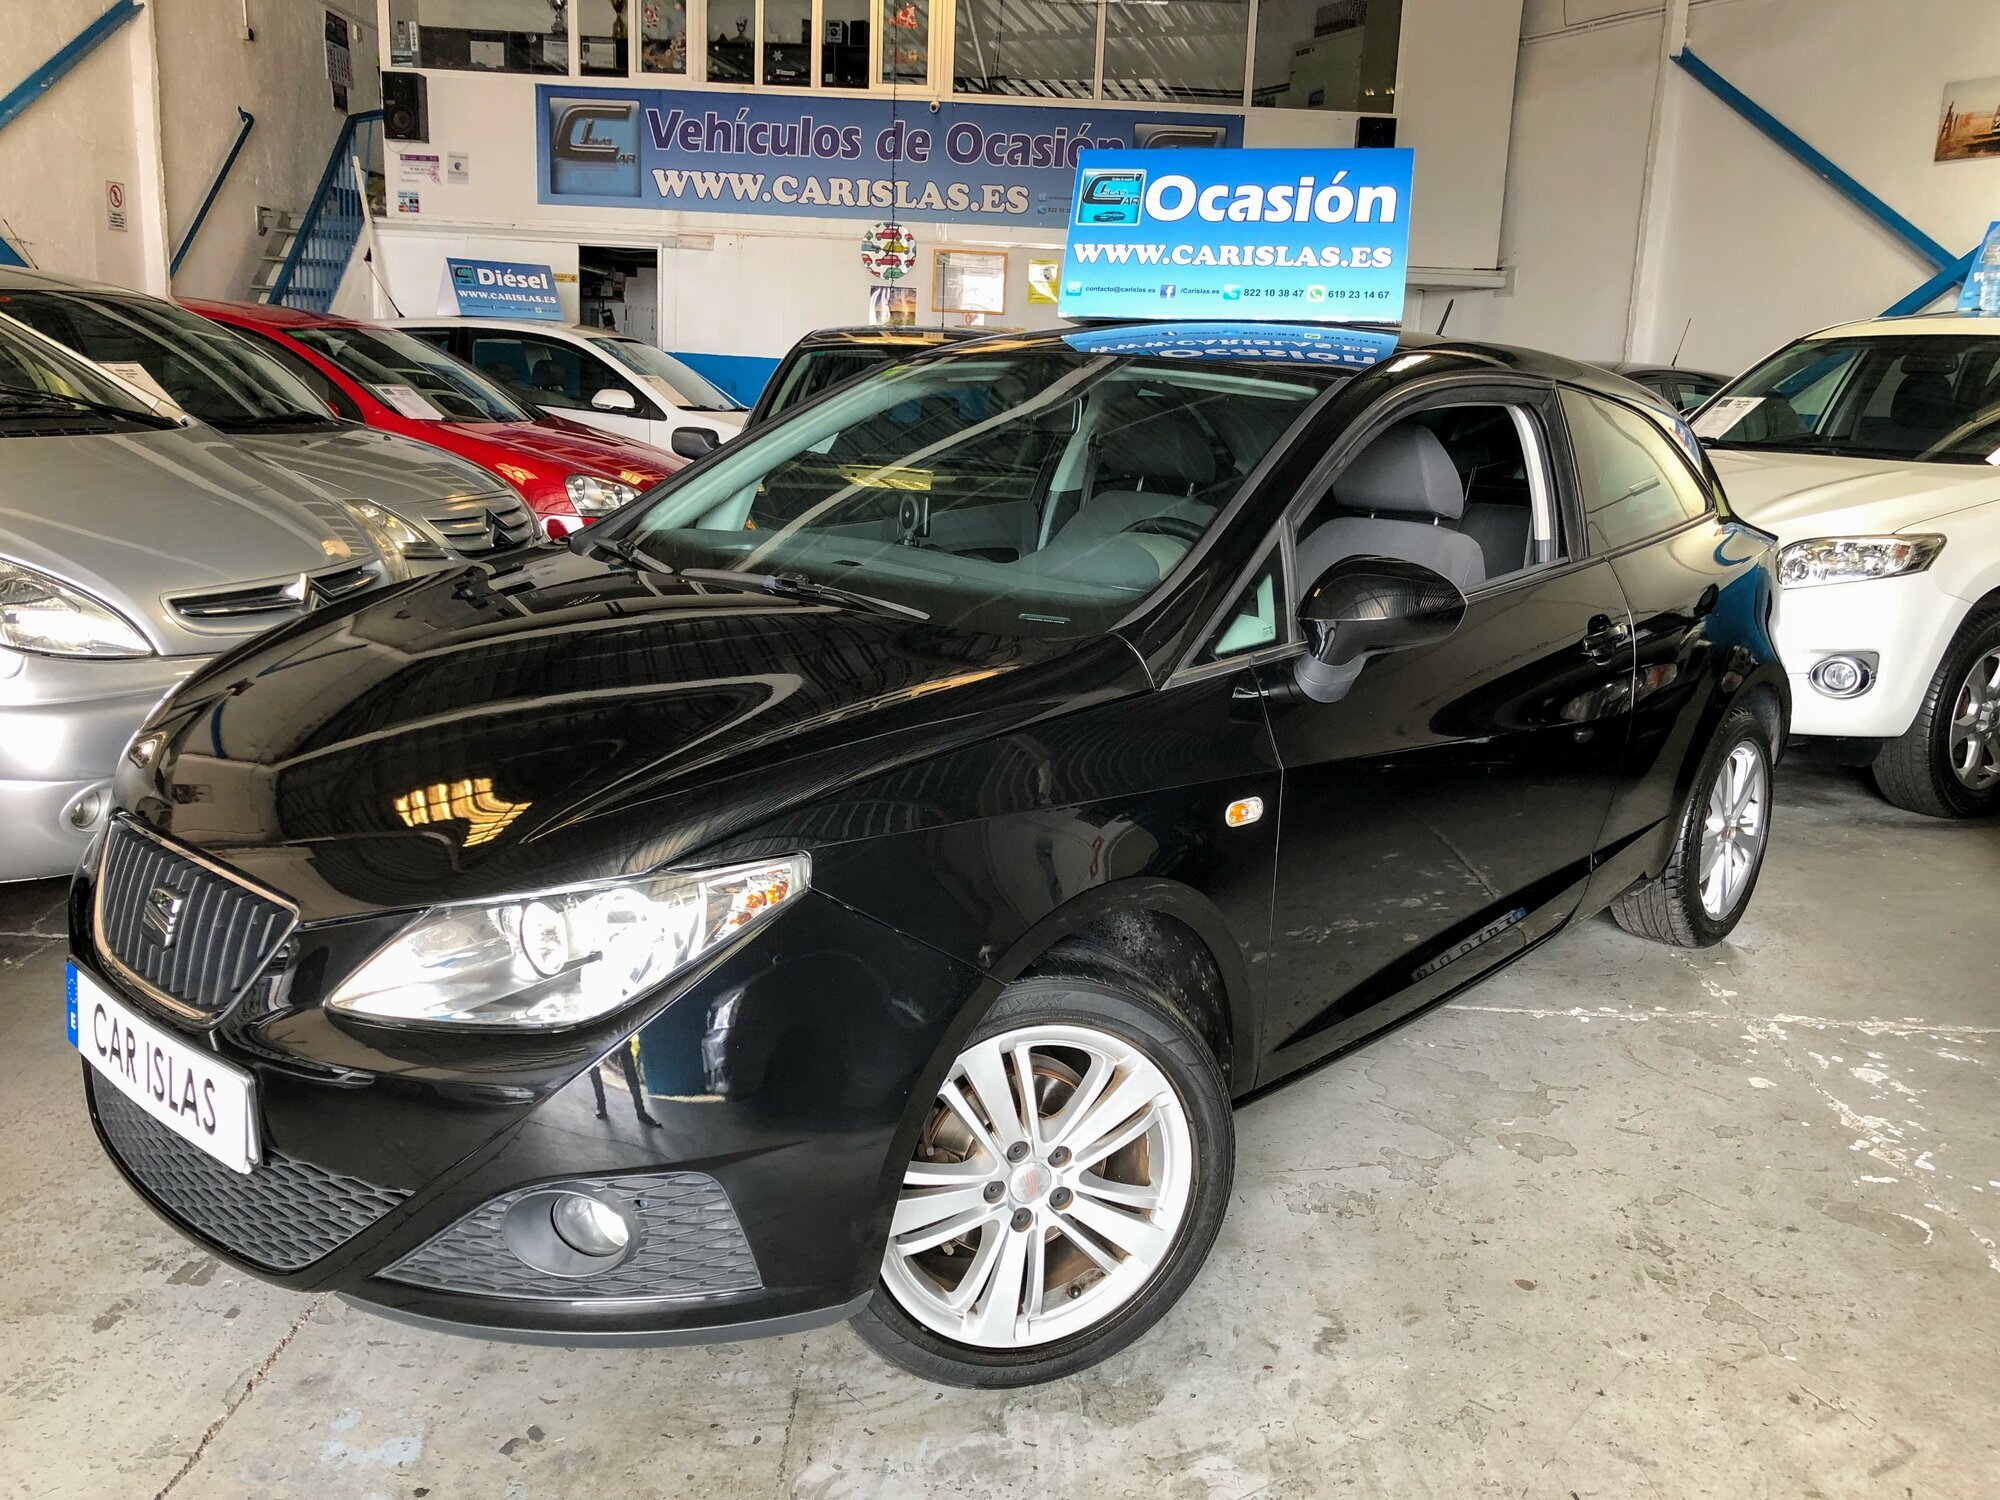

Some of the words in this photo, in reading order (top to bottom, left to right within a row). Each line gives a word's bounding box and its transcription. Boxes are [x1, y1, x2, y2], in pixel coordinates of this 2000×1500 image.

[645, 107, 862, 161] Vehículos
[876, 120, 932, 163] de
[651, 169, 1030, 214] WWW.CARISLAS.ES
[1144, 170, 1398, 223] Ocasión
[1073, 243, 1393, 269] WWW.CARISLAS.ES
[476, 268, 549, 290] Diésel
[1085, 285, 1156, 294] contacto@carislas.es
[458, 290, 557, 304] WWW.CARISLAS.ES
[1243, 288, 1261, 297] 822
[1264, 289, 1275, 297] 10
[1278, 289, 1290, 297] 38
[1292, 289, 1304, 297] 47
[1328, 290, 1345, 298] 619
[1348, 291, 1360, 299] 23
[1364, 291, 1375, 299] 14
[1378, 291, 1389, 299] 67
[70, 1011, 77, 1030] E
[94, 1003, 137, 1084] CAR
[146, 1041, 216, 1136] ISLAS
